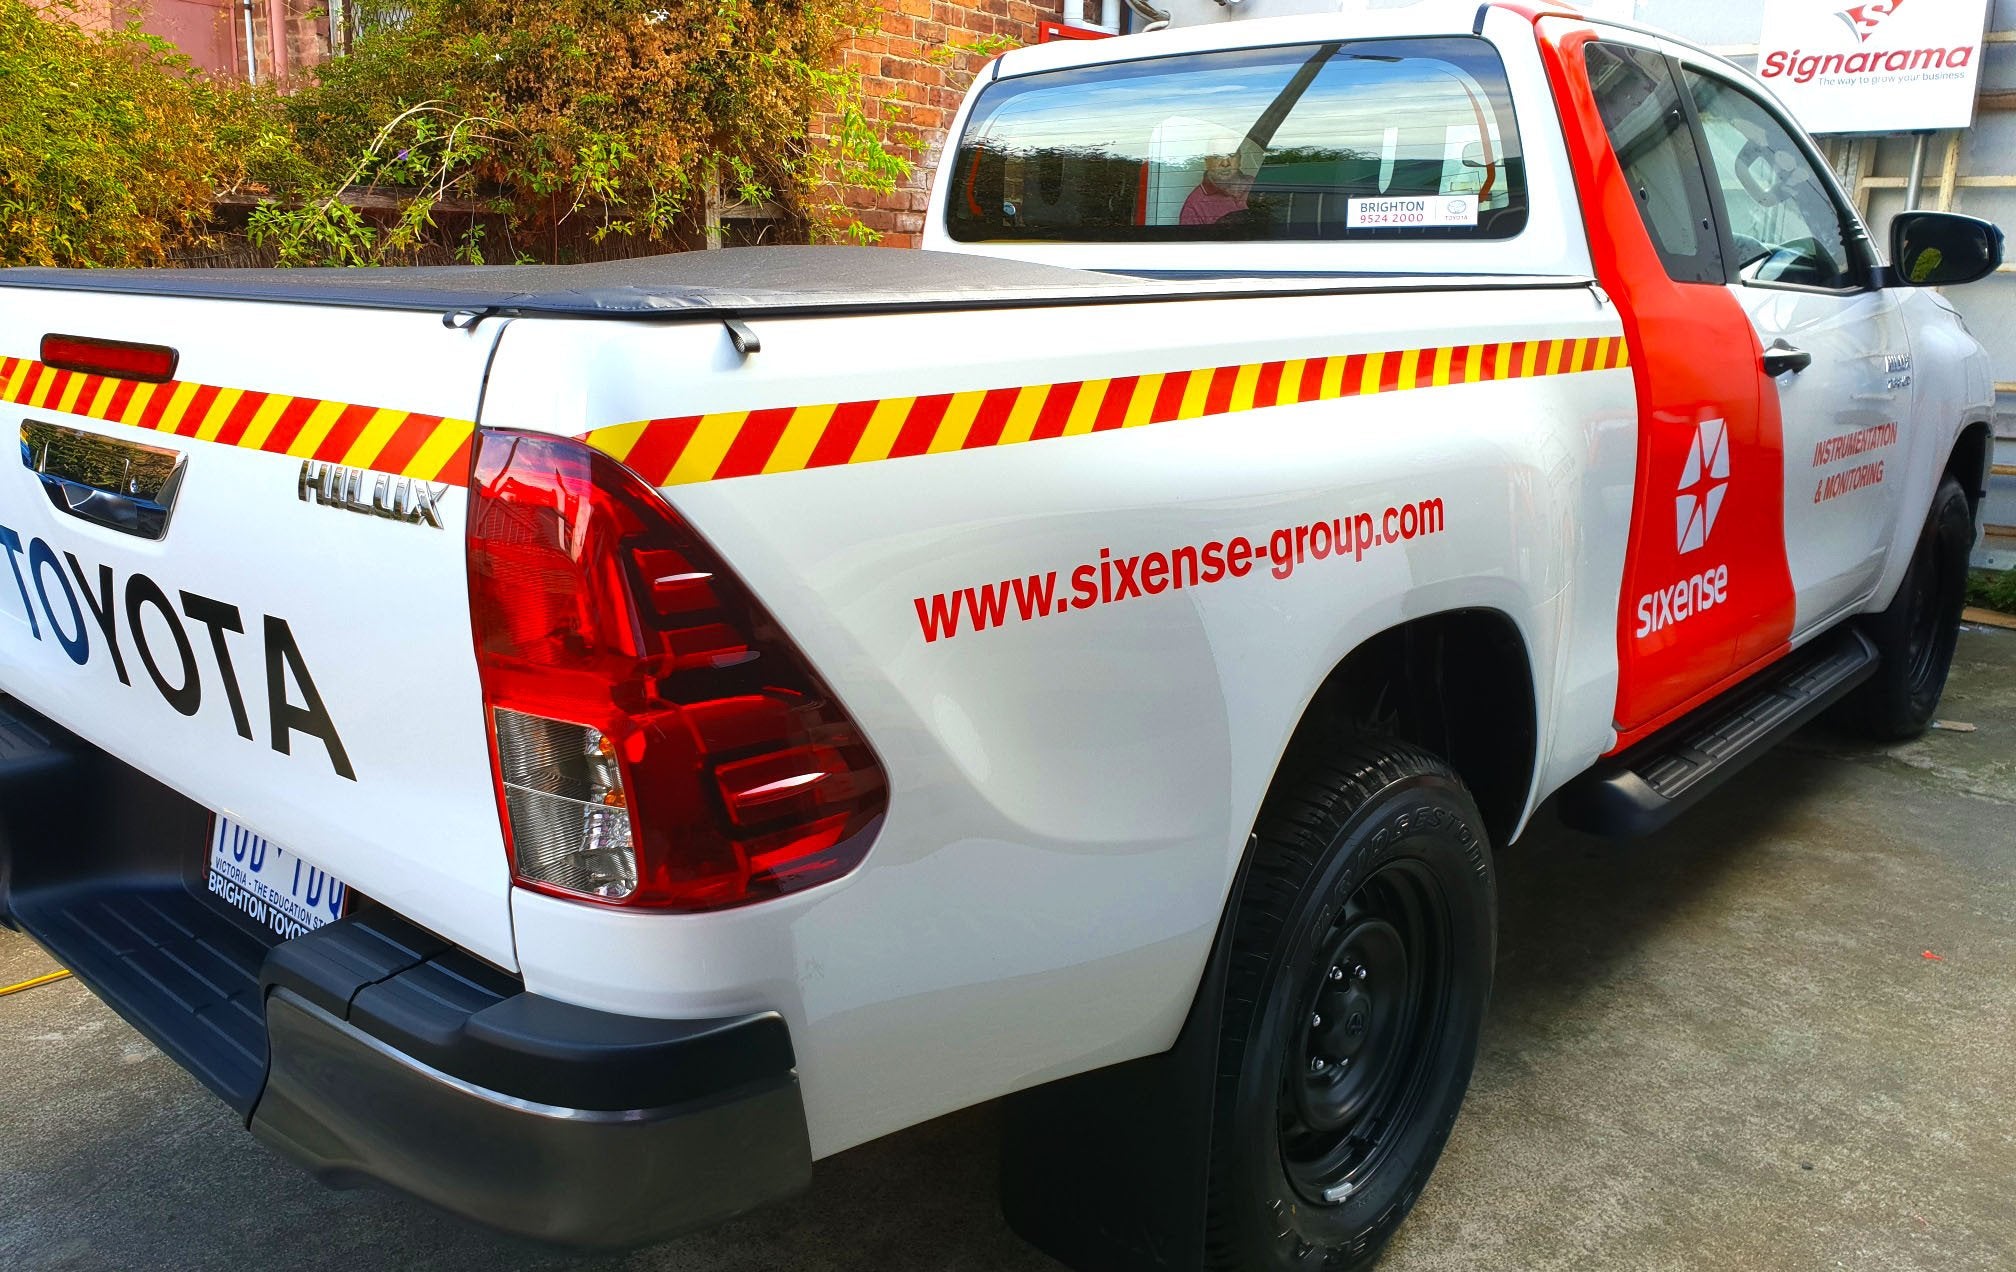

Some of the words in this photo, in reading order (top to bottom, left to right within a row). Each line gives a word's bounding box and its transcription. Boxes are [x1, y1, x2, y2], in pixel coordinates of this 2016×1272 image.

[1761, 46, 1974, 84] Signarama
[1818, 77, 1835, 86] The
[1837, 77, 1856, 87] way
[1859, 76, 1870, 84] to
[1871, 76, 1895, 86] grow
[1898, 74, 1920, 84] your
[1922, 71, 1965, 81] business
[1360, 201, 1424, 213] BRIGHTON
[1360, 214, 1388, 224] 9524
[1392, 213, 1424, 223] 2000
[1812, 421, 1898, 468] INSTRUMENTATION
[298, 459, 450, 530] HILUX
[1814, 480, 1823, 504] &
[1823, 460, 1885, 501] MONITORING
[914, 497, 1445, 643] www.sixense-group.com
[1636, 564, 1728, 638] sixense
[0, 525, 358, 782] TOYOTA
[208, 870, 267, 924] BRIGHTON
[215, 856, 247, 886] VICTORIA
[253, 879, 268, 901] THE
[269, 890, 312, 926] EDUCATION
